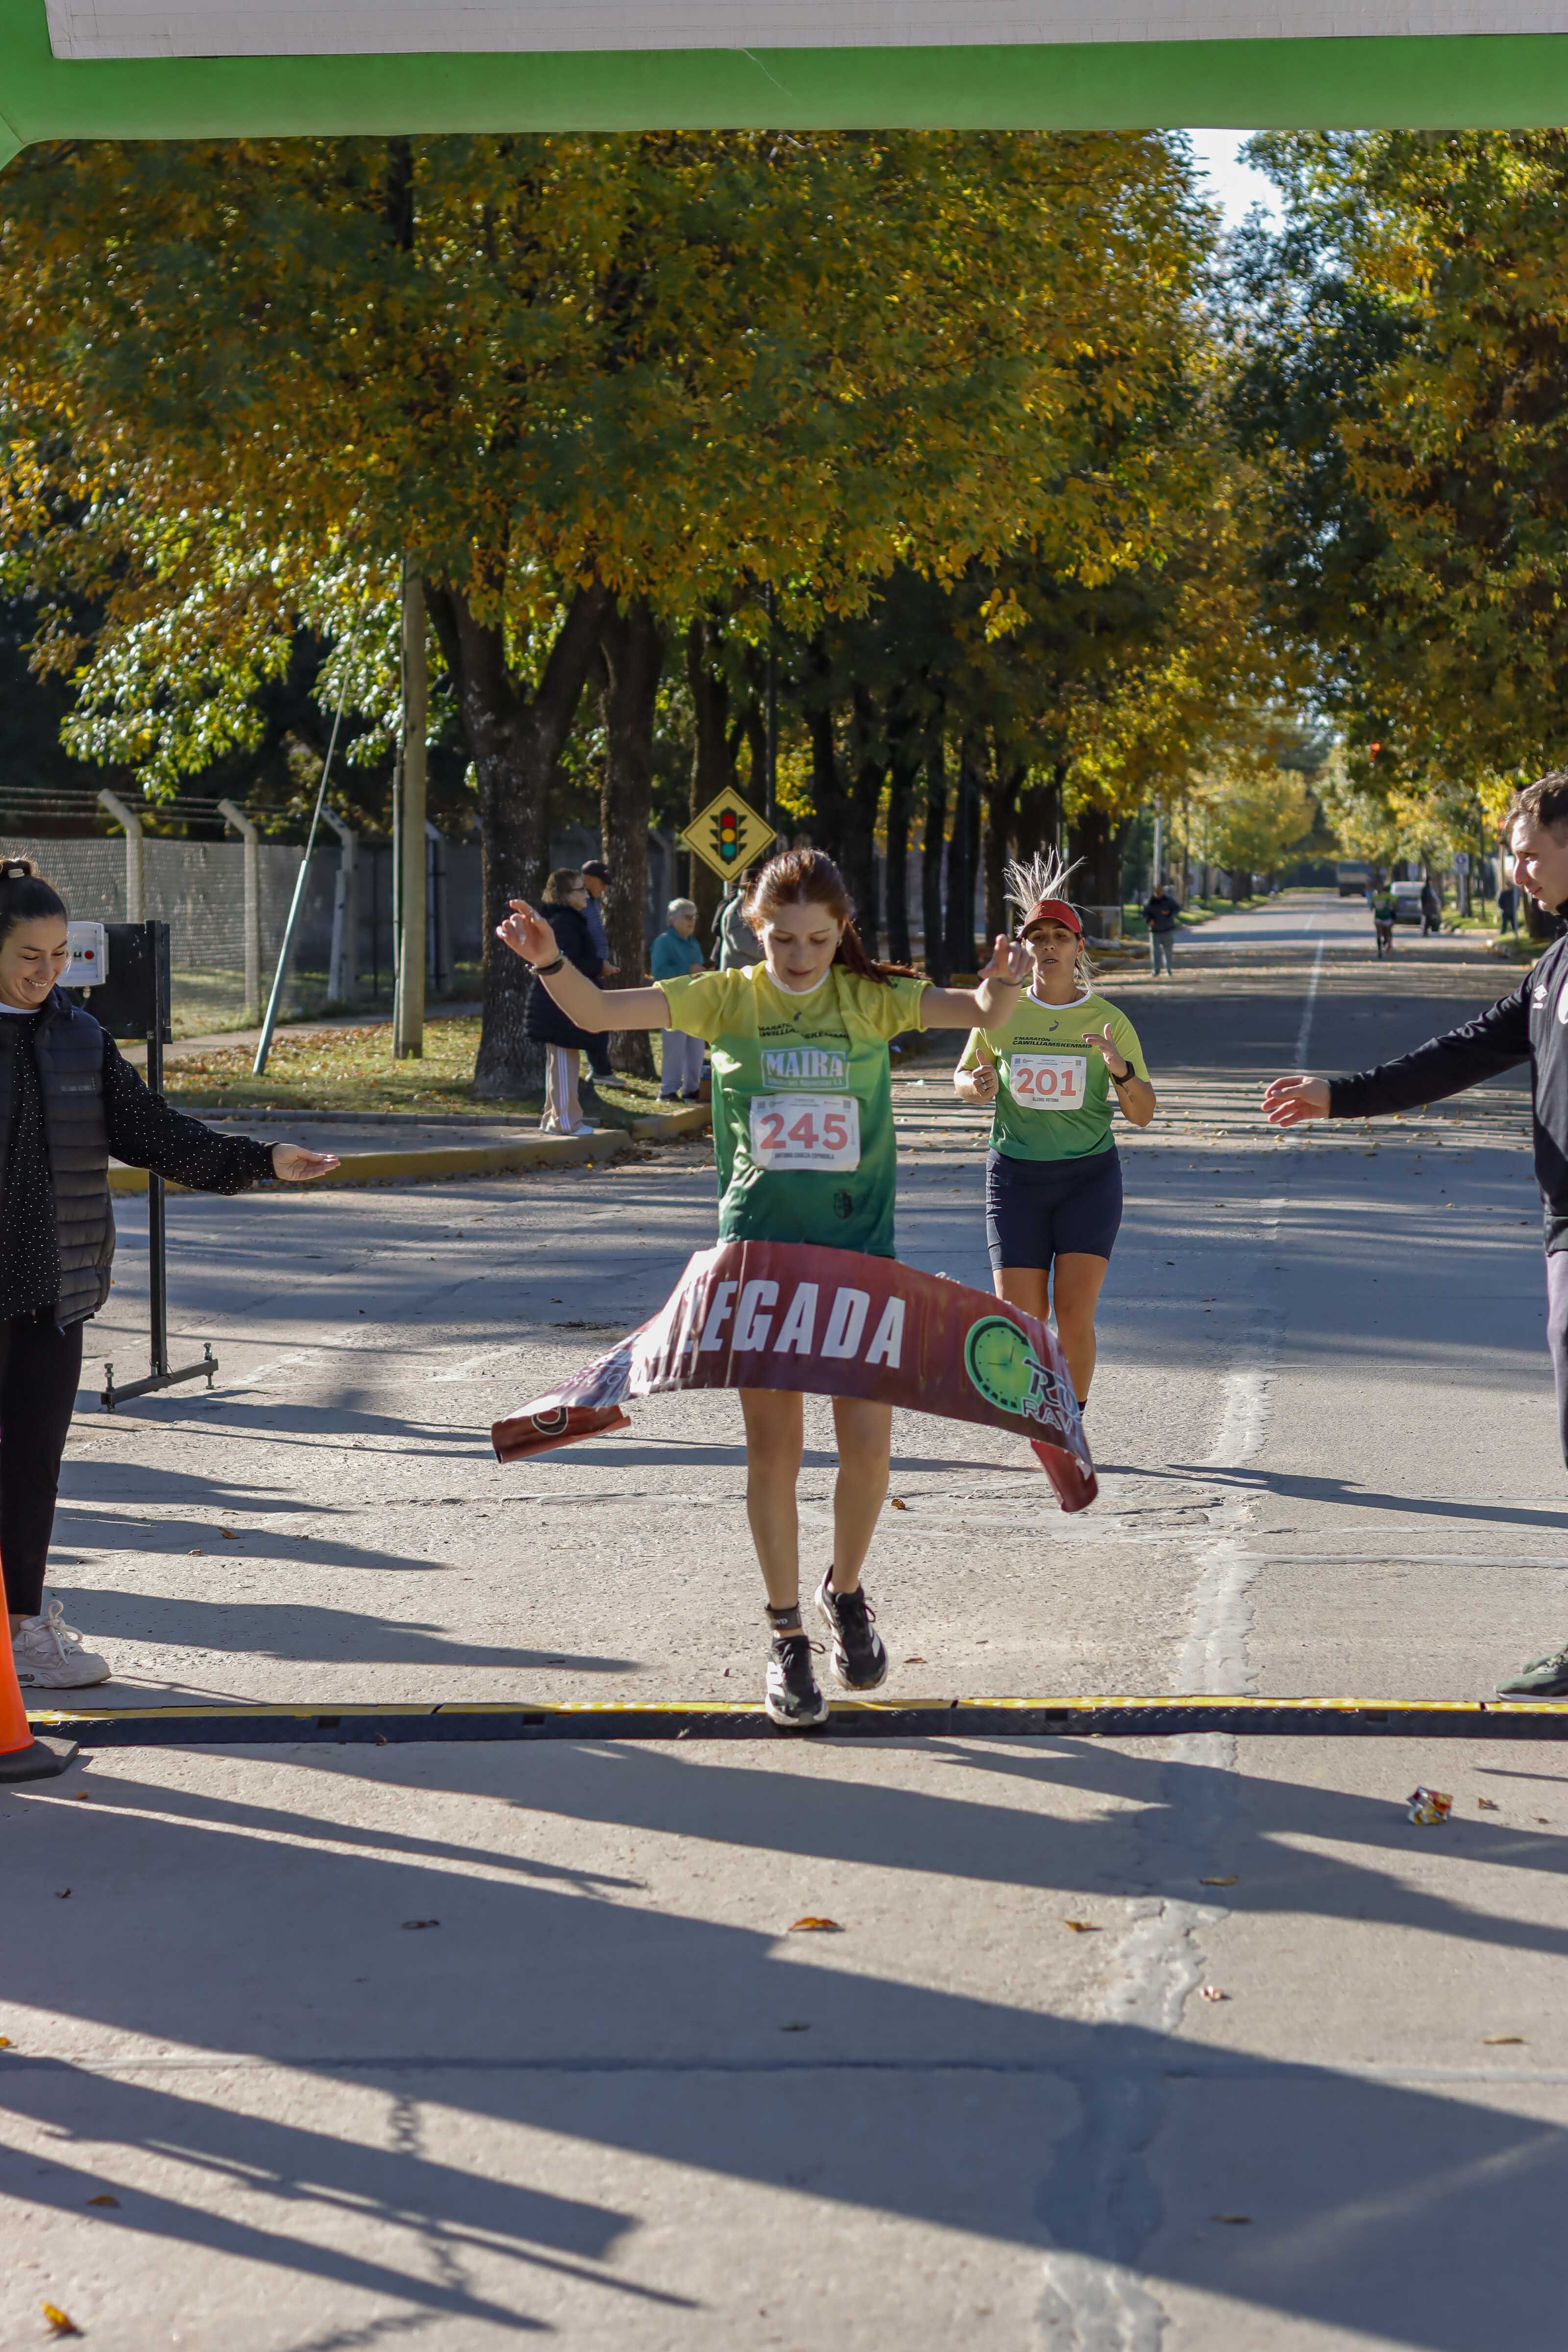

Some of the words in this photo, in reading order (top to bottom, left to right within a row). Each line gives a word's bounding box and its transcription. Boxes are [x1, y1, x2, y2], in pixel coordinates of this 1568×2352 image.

[766, 1050, 843, 1077] MAIRA
[1017, 1068, 1076, 1096] 201
[760, 1113, 848, 1150] 245
